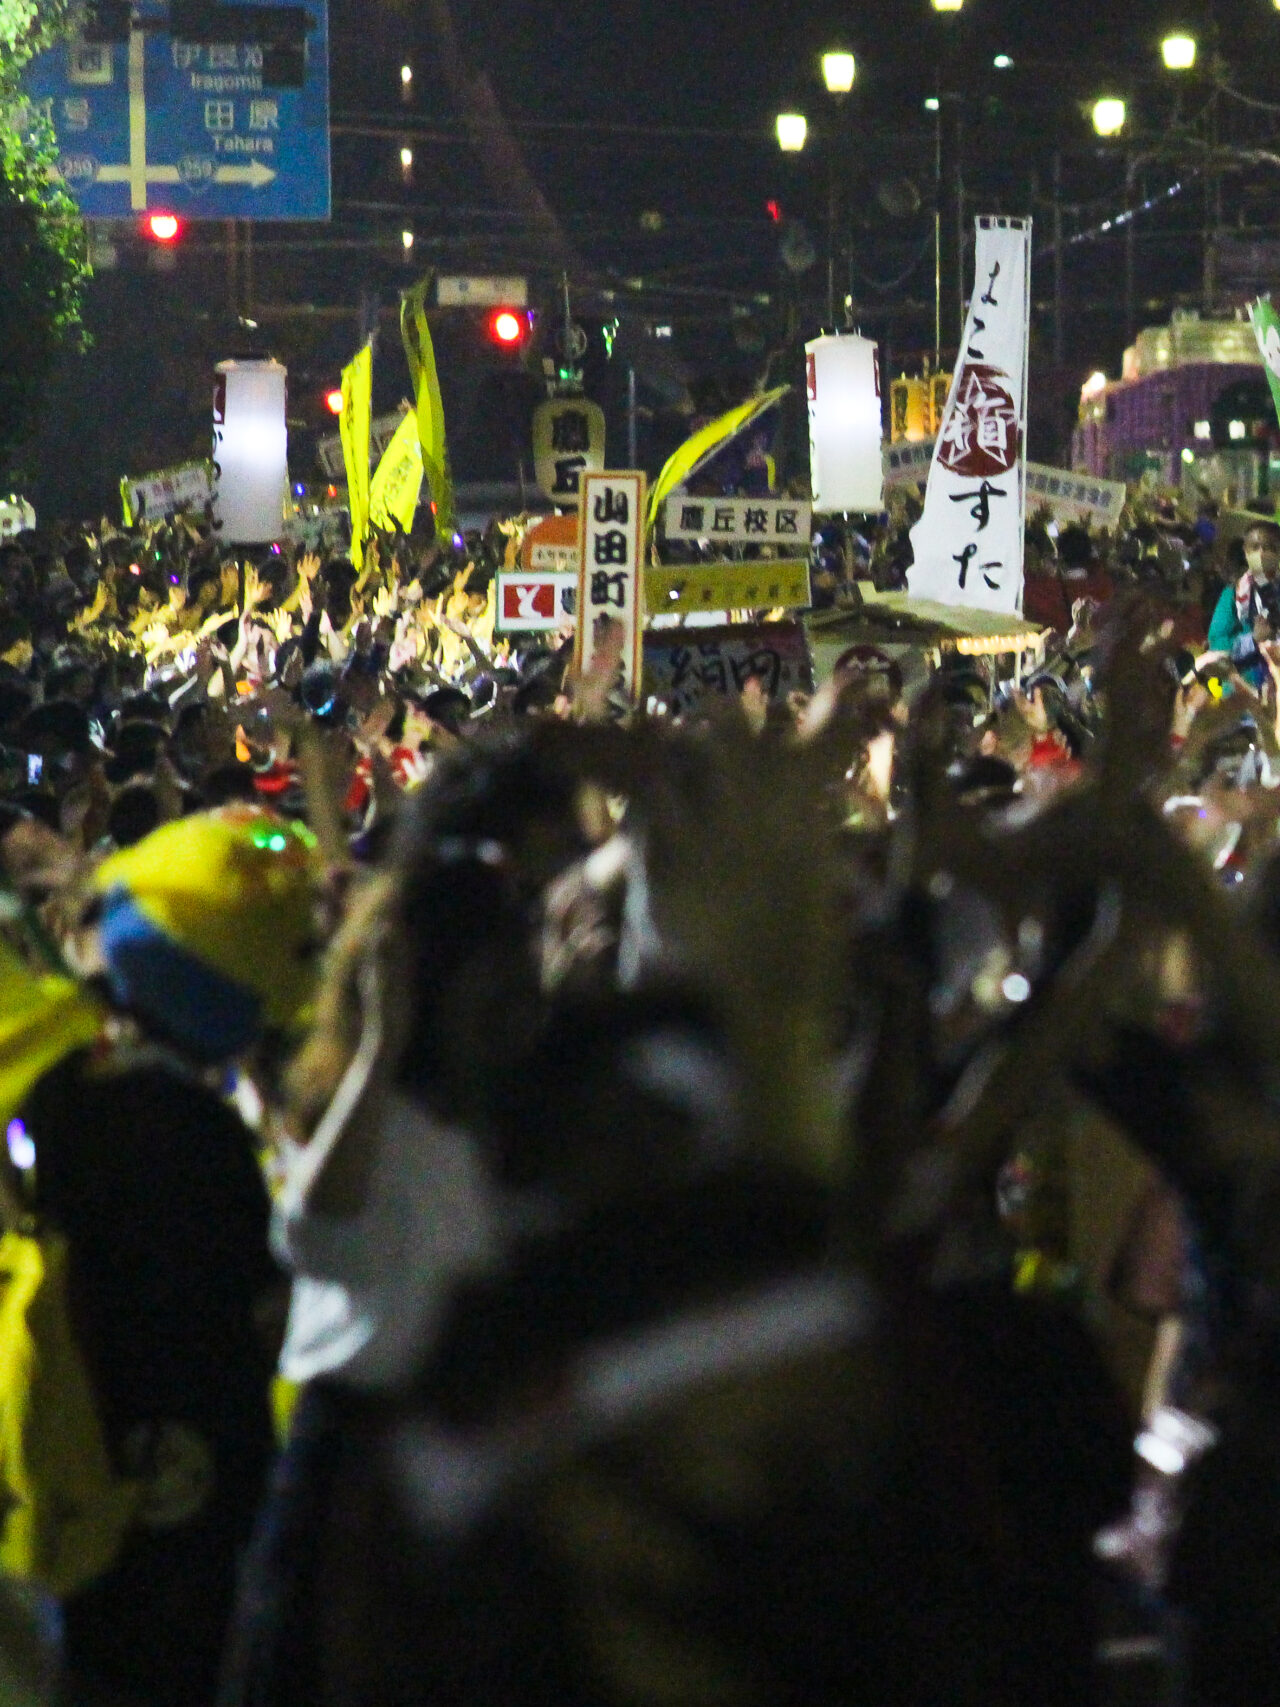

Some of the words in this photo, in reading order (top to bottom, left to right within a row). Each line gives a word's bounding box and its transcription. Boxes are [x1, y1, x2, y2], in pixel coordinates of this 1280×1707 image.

[205, 101, 278, 129] 田原
[213, 134, 273, 152] Tahara
[590, 487, 629, 645] 山田町
